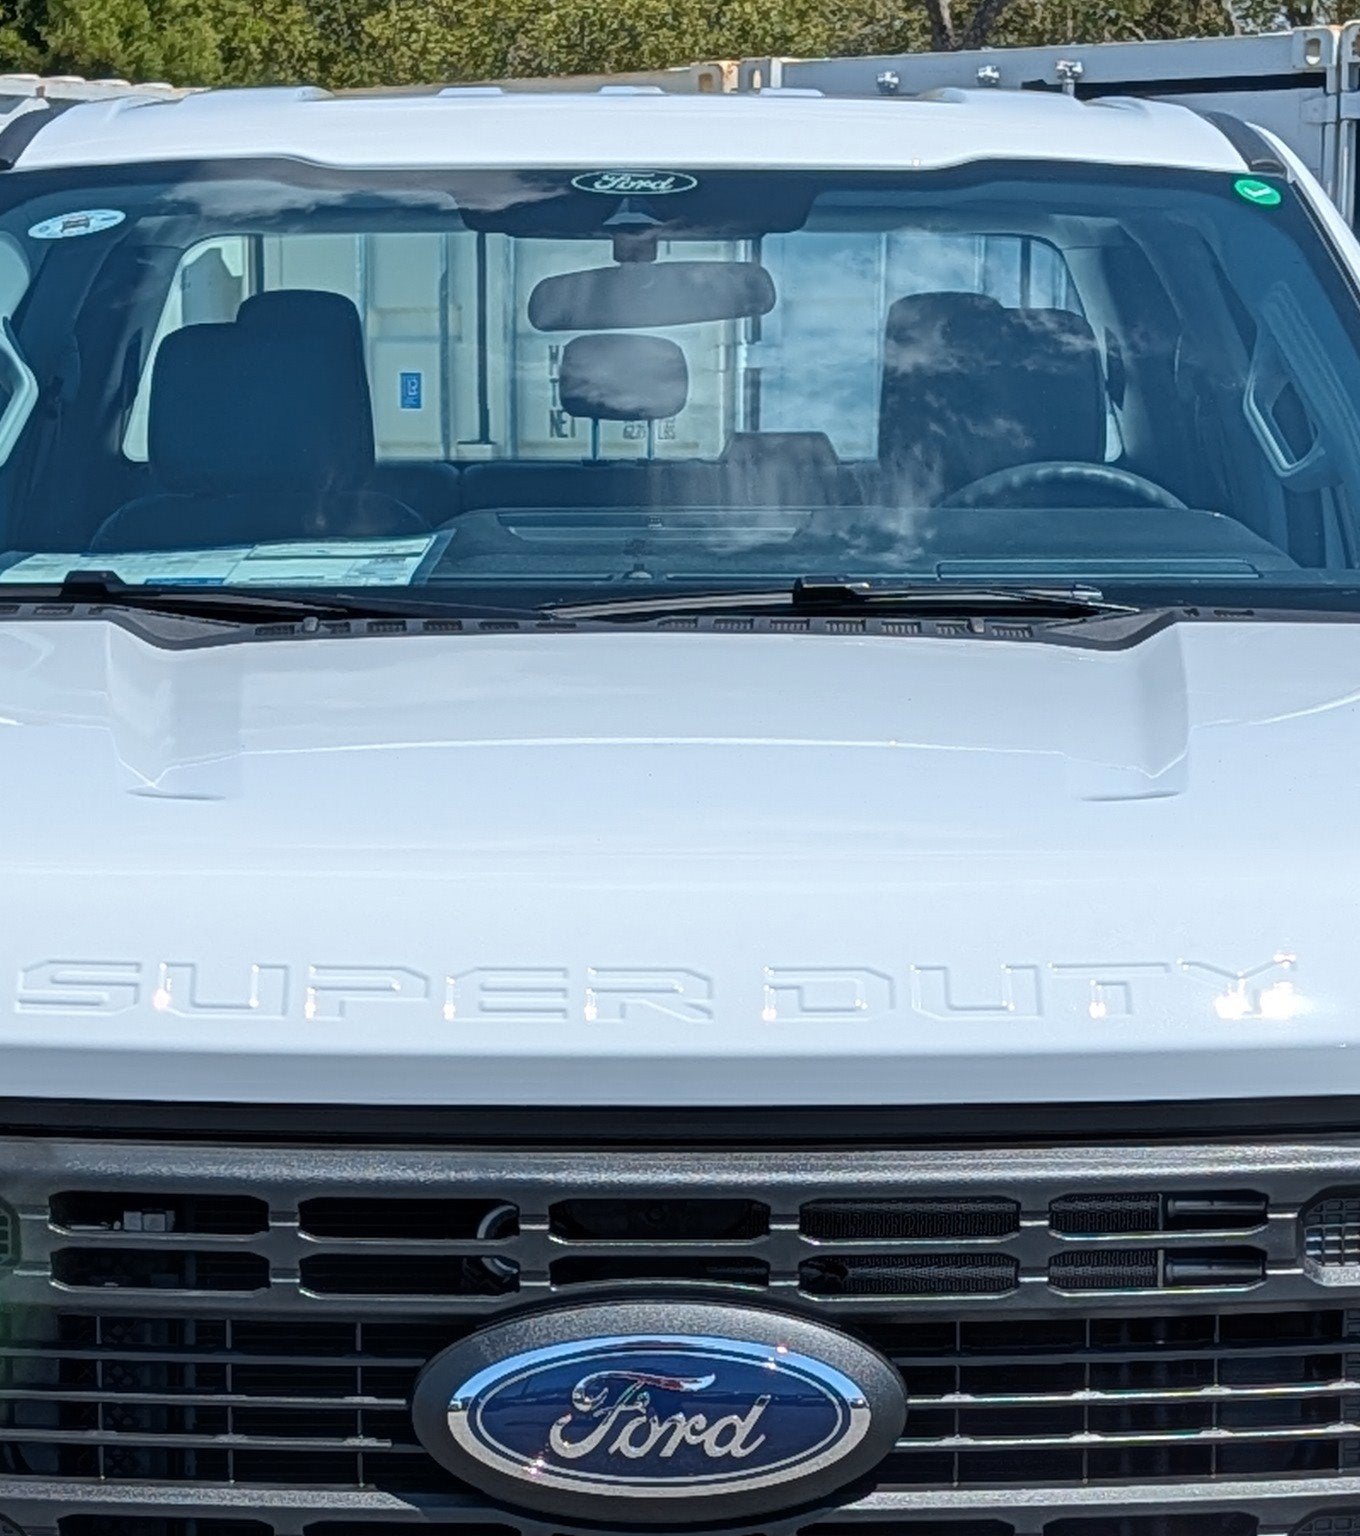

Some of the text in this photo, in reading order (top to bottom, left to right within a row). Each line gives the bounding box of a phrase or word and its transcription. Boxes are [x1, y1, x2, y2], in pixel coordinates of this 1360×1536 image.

[593, 172, 675, 190] Ford
[15, 956, 1296, 1023] SUPER DUTY
[549, 1370, 771, 1460] Ford
